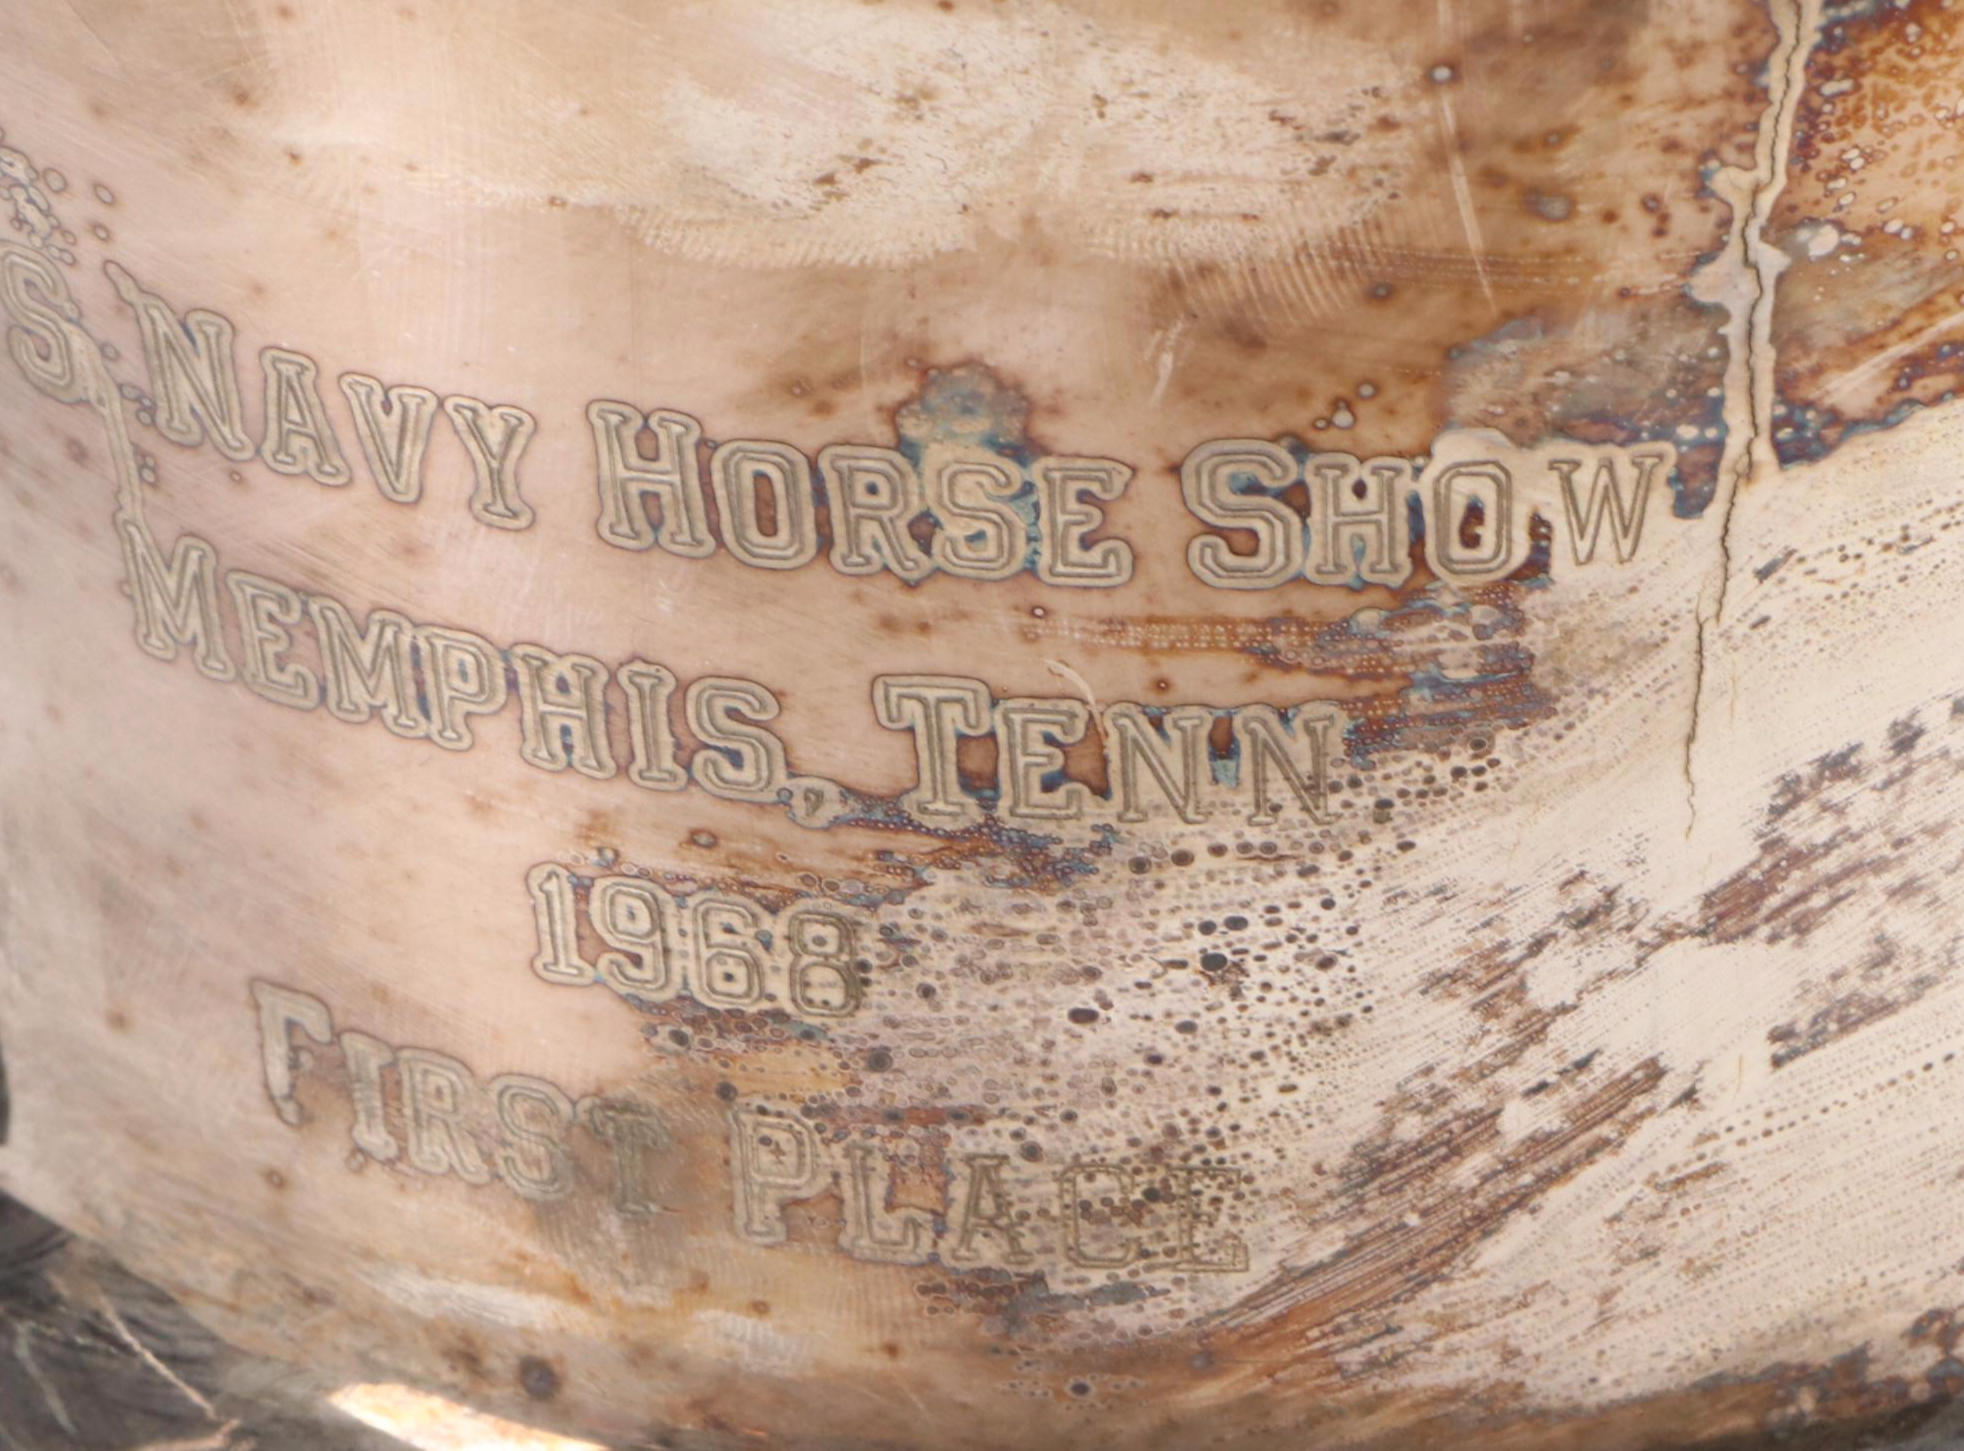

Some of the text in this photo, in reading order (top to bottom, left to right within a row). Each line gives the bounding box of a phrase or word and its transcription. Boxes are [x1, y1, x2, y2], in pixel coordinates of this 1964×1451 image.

[128, 284, 536, 530] NAVY
[587, 400, 1134, 588] HORSE
[1181, 436, 1676, 588] SHOW
[527, 863, 868, 1022] 1968
[249, 977, 1250, 1274] FIRST PLACE
